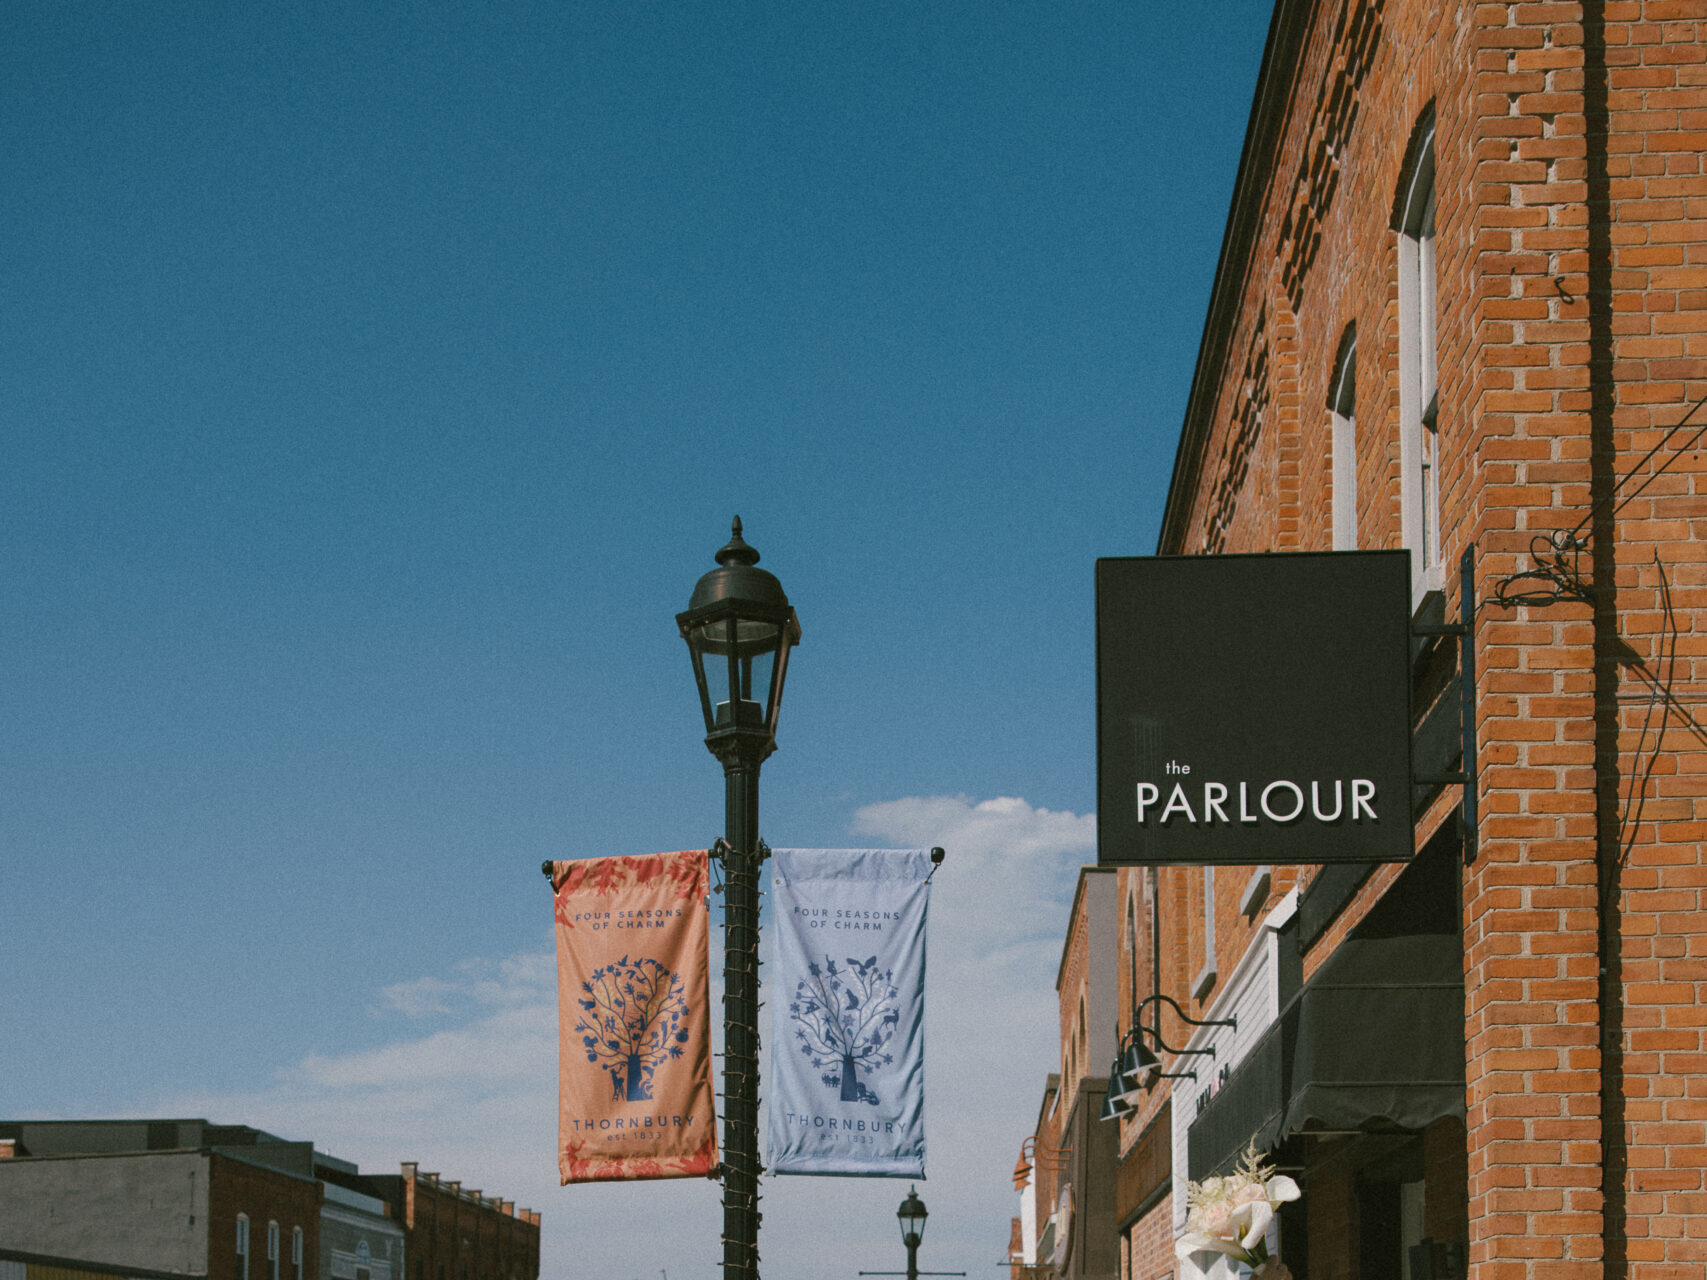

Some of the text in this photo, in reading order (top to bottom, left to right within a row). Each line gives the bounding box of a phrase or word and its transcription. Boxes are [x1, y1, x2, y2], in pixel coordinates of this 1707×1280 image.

[1165, 759, 1191, 775] the
[1136, 778, 1378, 823] PARLOUR
[575, 908, 682, 921] FOUR SEASONS
[794, 906, 901, 920] FOUR SEASONS
[592, 920, 665, 931] OF CHARM
[810, 920, 882, 931] OF CHARM
[572, 1115, 694, 1131] THORNBURY
[786, 1113, 906, 1134] THORNBURY
[607, 1131, 663, 1141] est 1833
[847, 1134, 874, 1144] 1833
